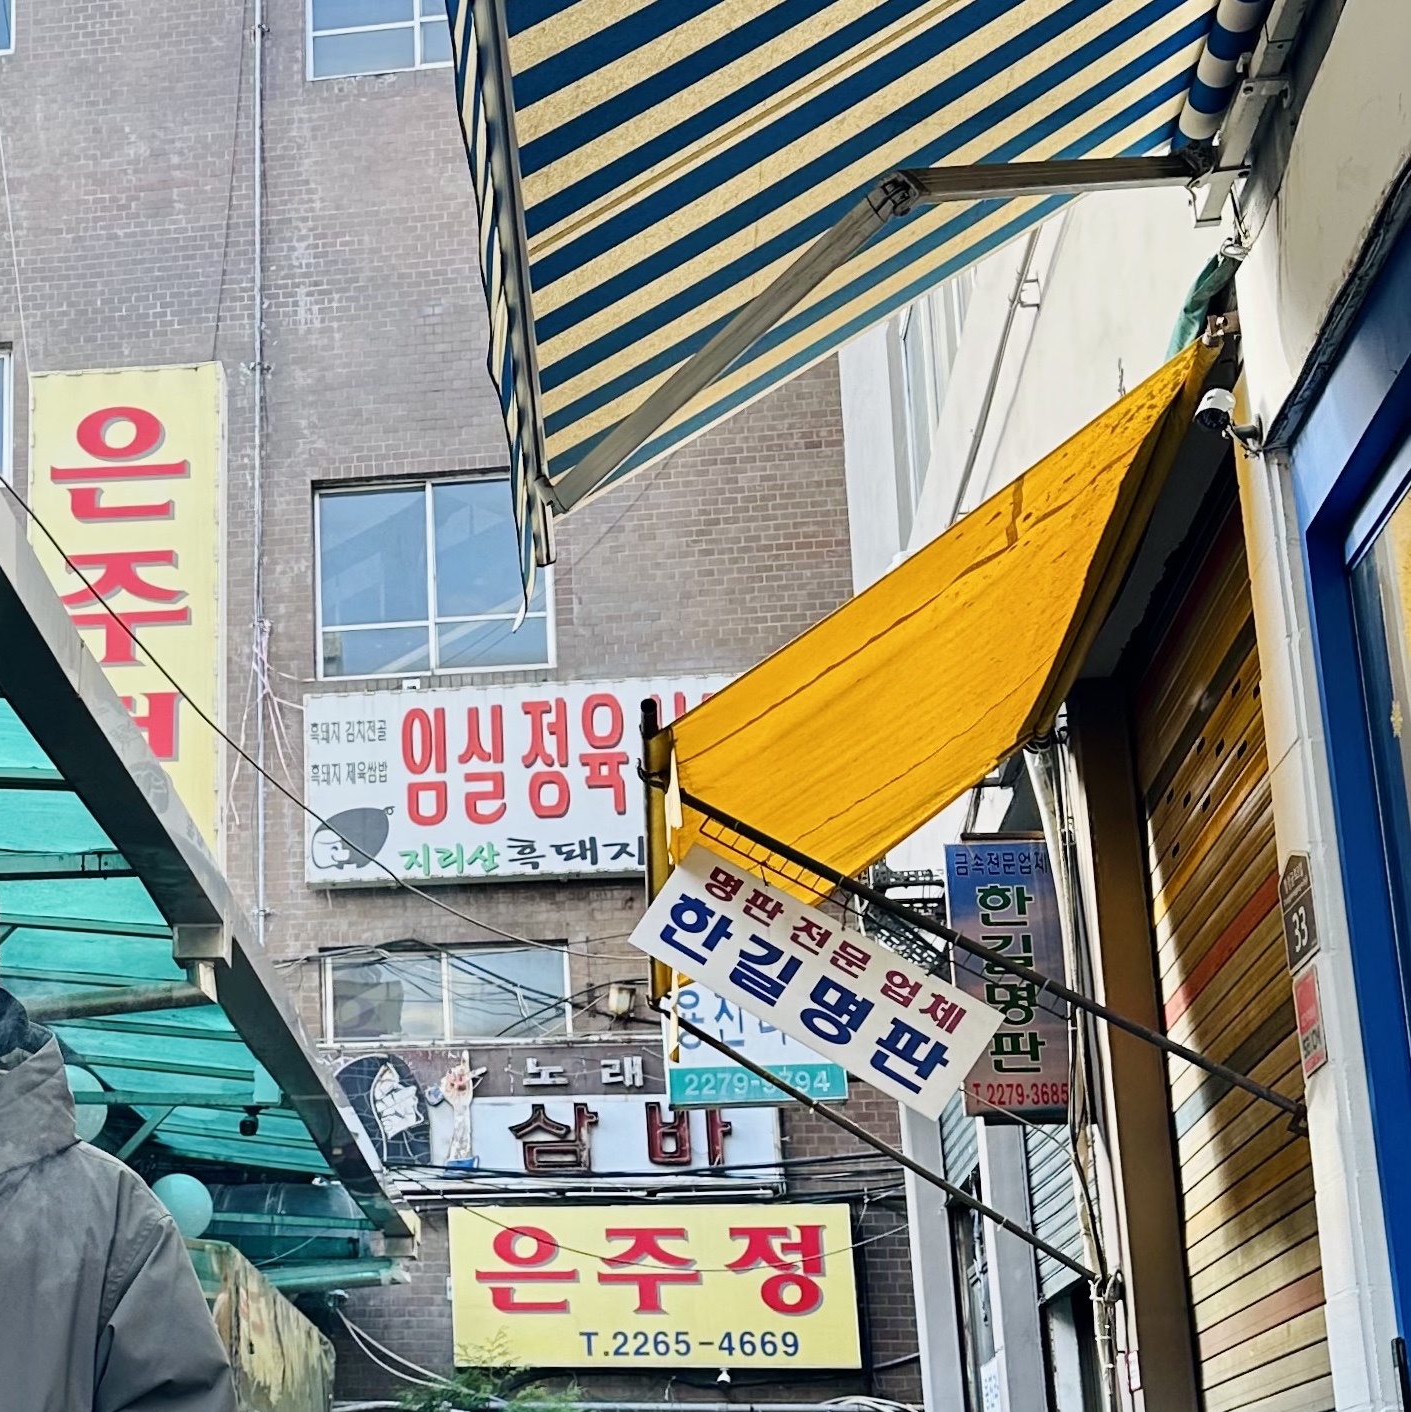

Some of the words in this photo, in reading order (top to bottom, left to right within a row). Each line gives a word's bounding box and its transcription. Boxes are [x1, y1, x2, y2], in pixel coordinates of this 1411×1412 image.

[310, 721, 341, 745] 흑돼지
[345, 719, 387, 743] 김치전골
[401, 691, 714, 827] 임실정육
[311, 762, 341, 786] 흑돼지
[346, 760, 388, 785] 제육쌈밥
[399, 842, 502, 876] 지리산
[507, 836, 645, 870] 흑돼지
[704, 866, 785, 928] 명판
[790, 915, 873, 979] 전문
[880, 970, 968, 1035] 업체
[1292, 905, 1308, 953] 33
[659, 893, 950, 1095] 한길명판
[976, 884, 1046, 1074] 한길명판
[523, 1055, 644, 1088] 노래
[509, 1101, 733, 1175] 삼바
[475, 1224, 827, 1316] 은주정
